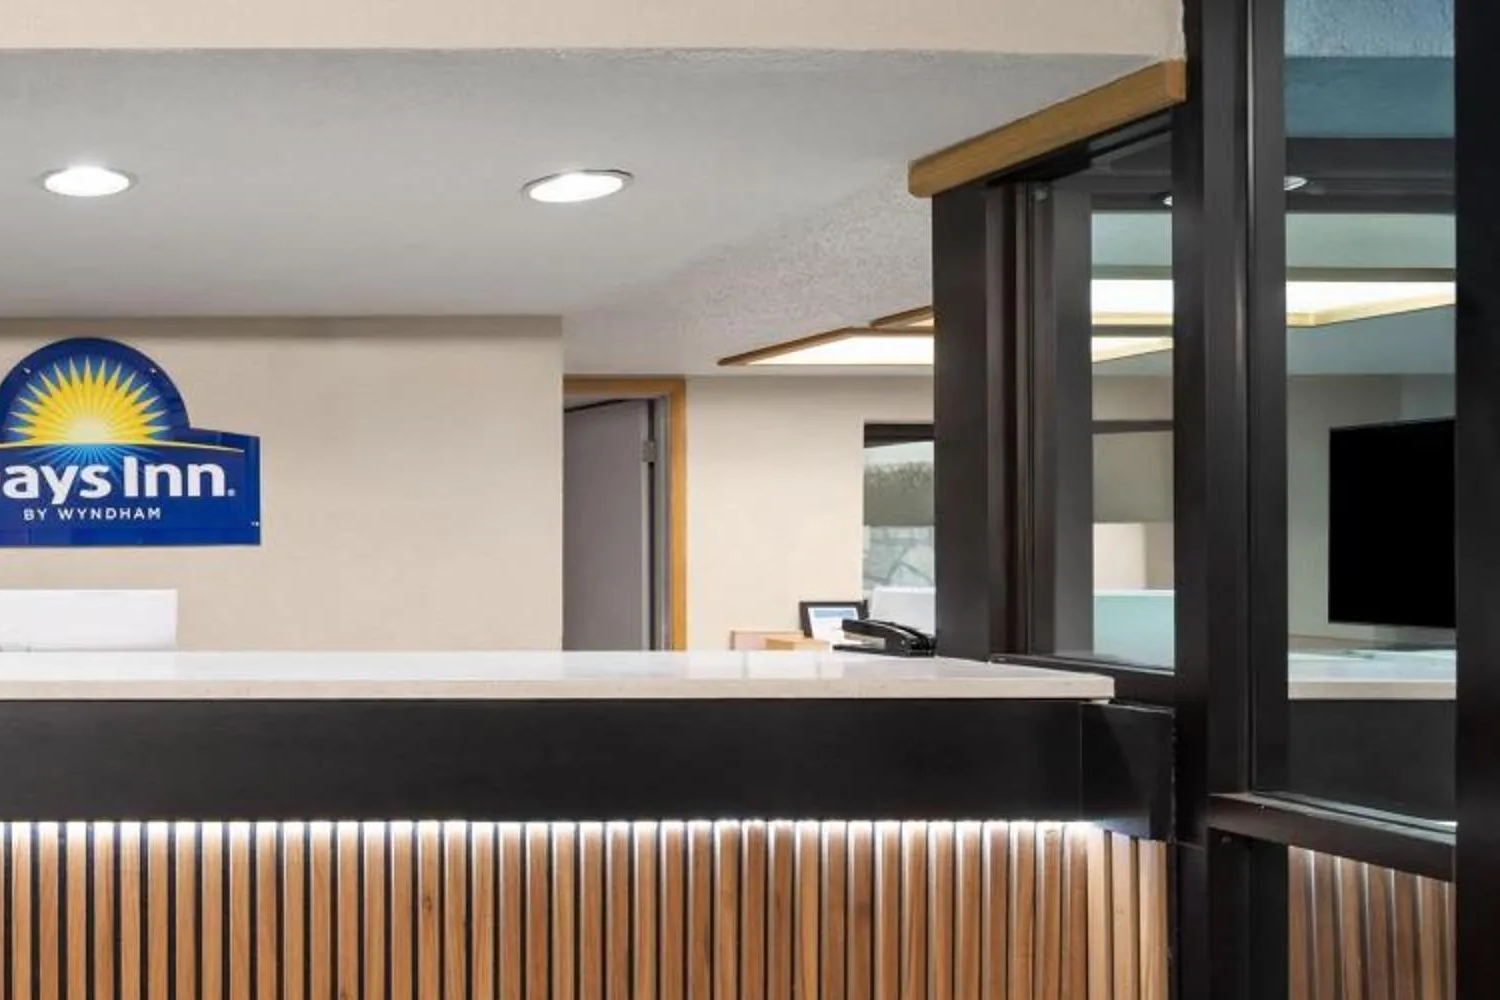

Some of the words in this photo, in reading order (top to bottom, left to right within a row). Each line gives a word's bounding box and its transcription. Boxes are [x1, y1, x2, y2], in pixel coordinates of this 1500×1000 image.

[123, 455, 226, 497] Inn
[23, 508, 47, 521] BY
[57, 507, 162, 521] WYNDHAM
